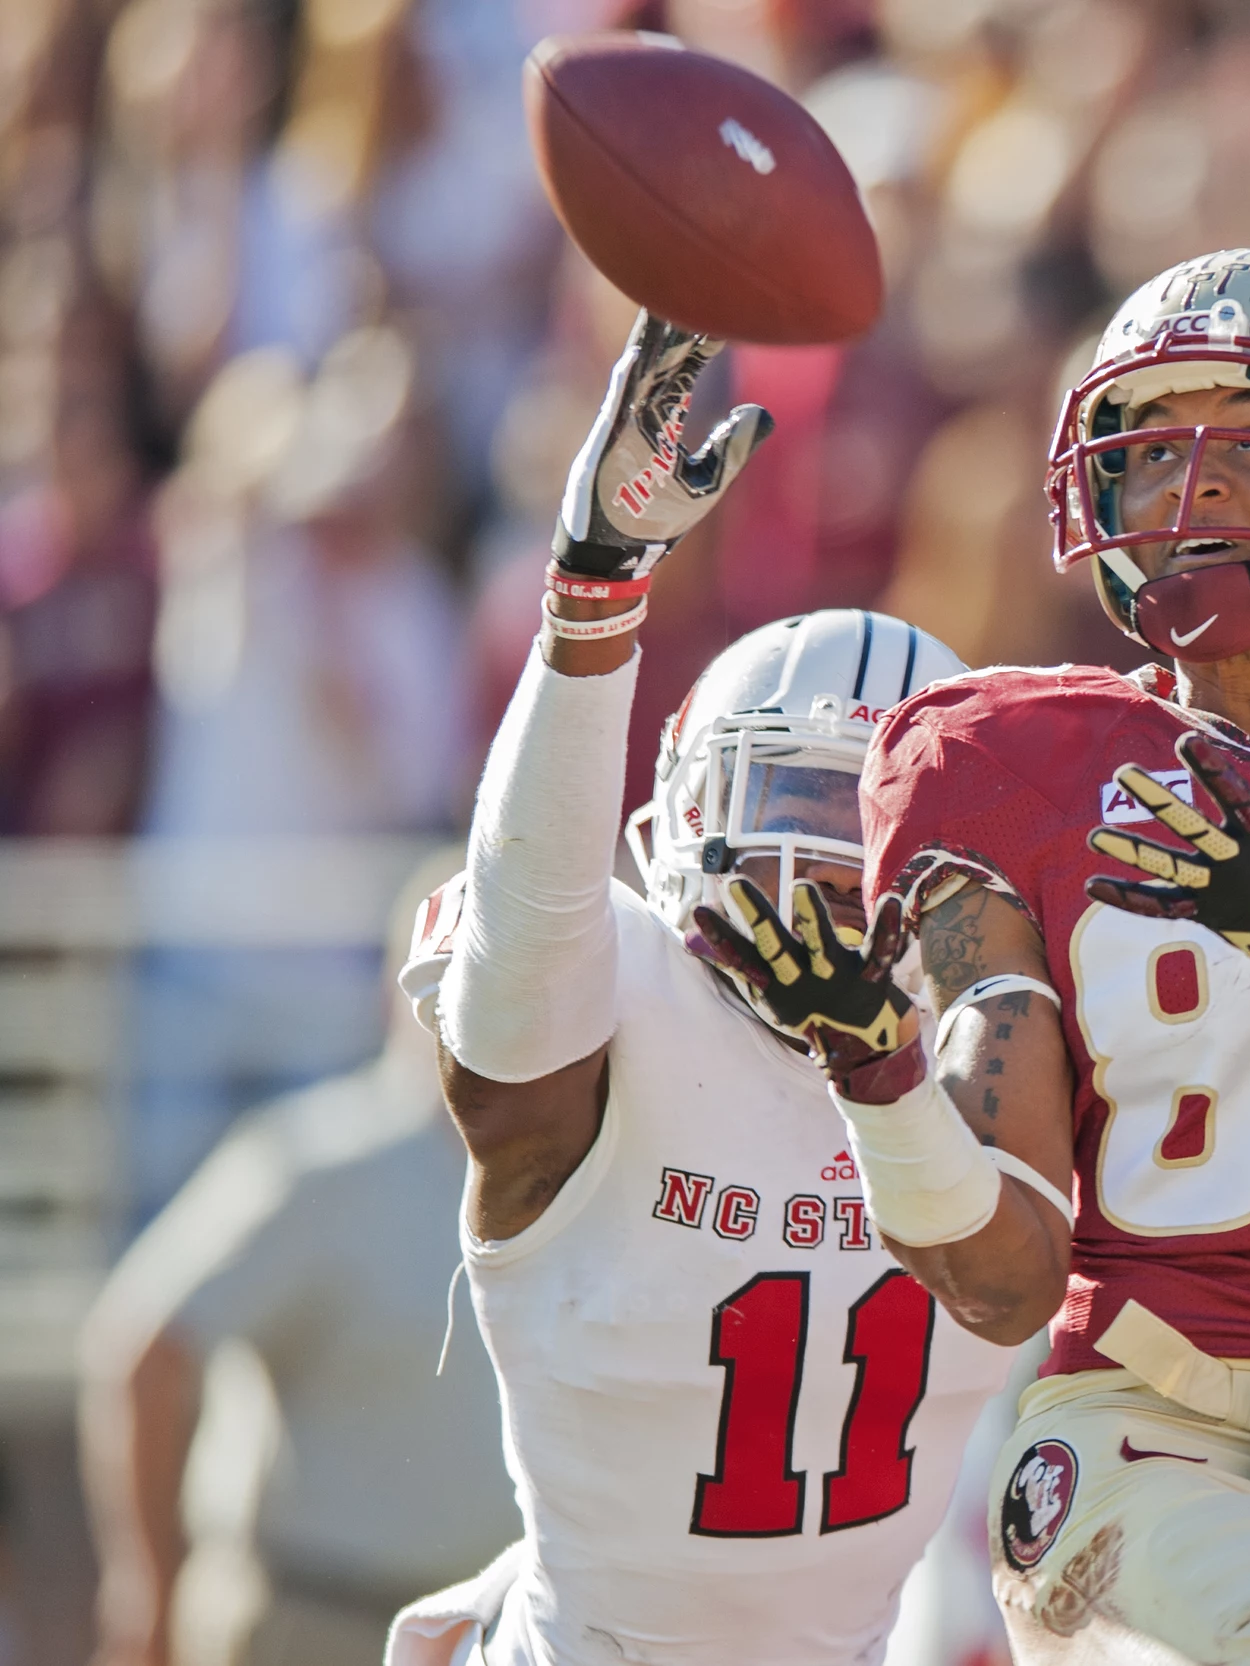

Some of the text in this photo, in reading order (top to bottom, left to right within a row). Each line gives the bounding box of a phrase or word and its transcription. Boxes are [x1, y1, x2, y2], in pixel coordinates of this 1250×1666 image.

[1151, 315, 1210, 338] ACC
[652, 1167, 886, 1251] NC ST
[689, 1268, 936, 1538] 11
